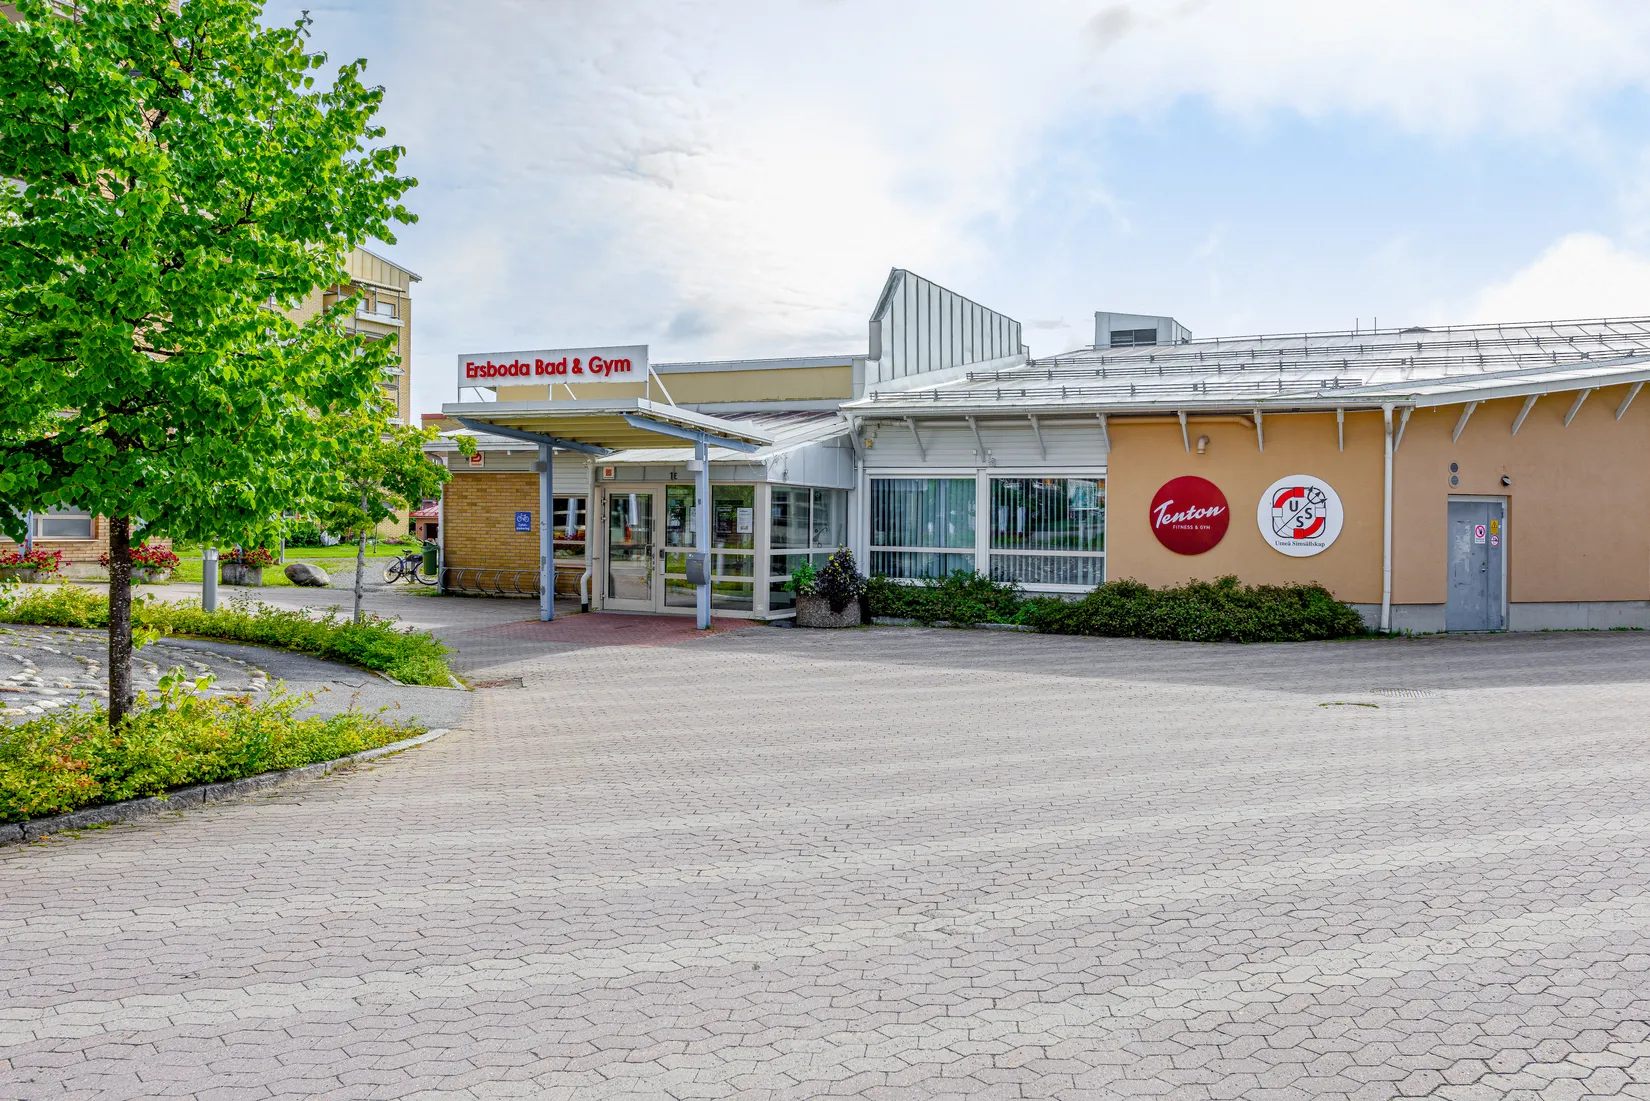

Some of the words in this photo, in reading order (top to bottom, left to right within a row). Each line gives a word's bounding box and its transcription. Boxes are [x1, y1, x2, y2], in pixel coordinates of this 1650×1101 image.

[466, 360, 530, 378] Ersboda
[535, 357, 567, 375] Bad
[571, 357, 583, 375] &
[588, 356, 631, 377] Gym
[670, 471, 678, 480] 1E
[1153, 499, 1226, 529] Tenton
[1292, 540, 1326, 548] Simsällskap
